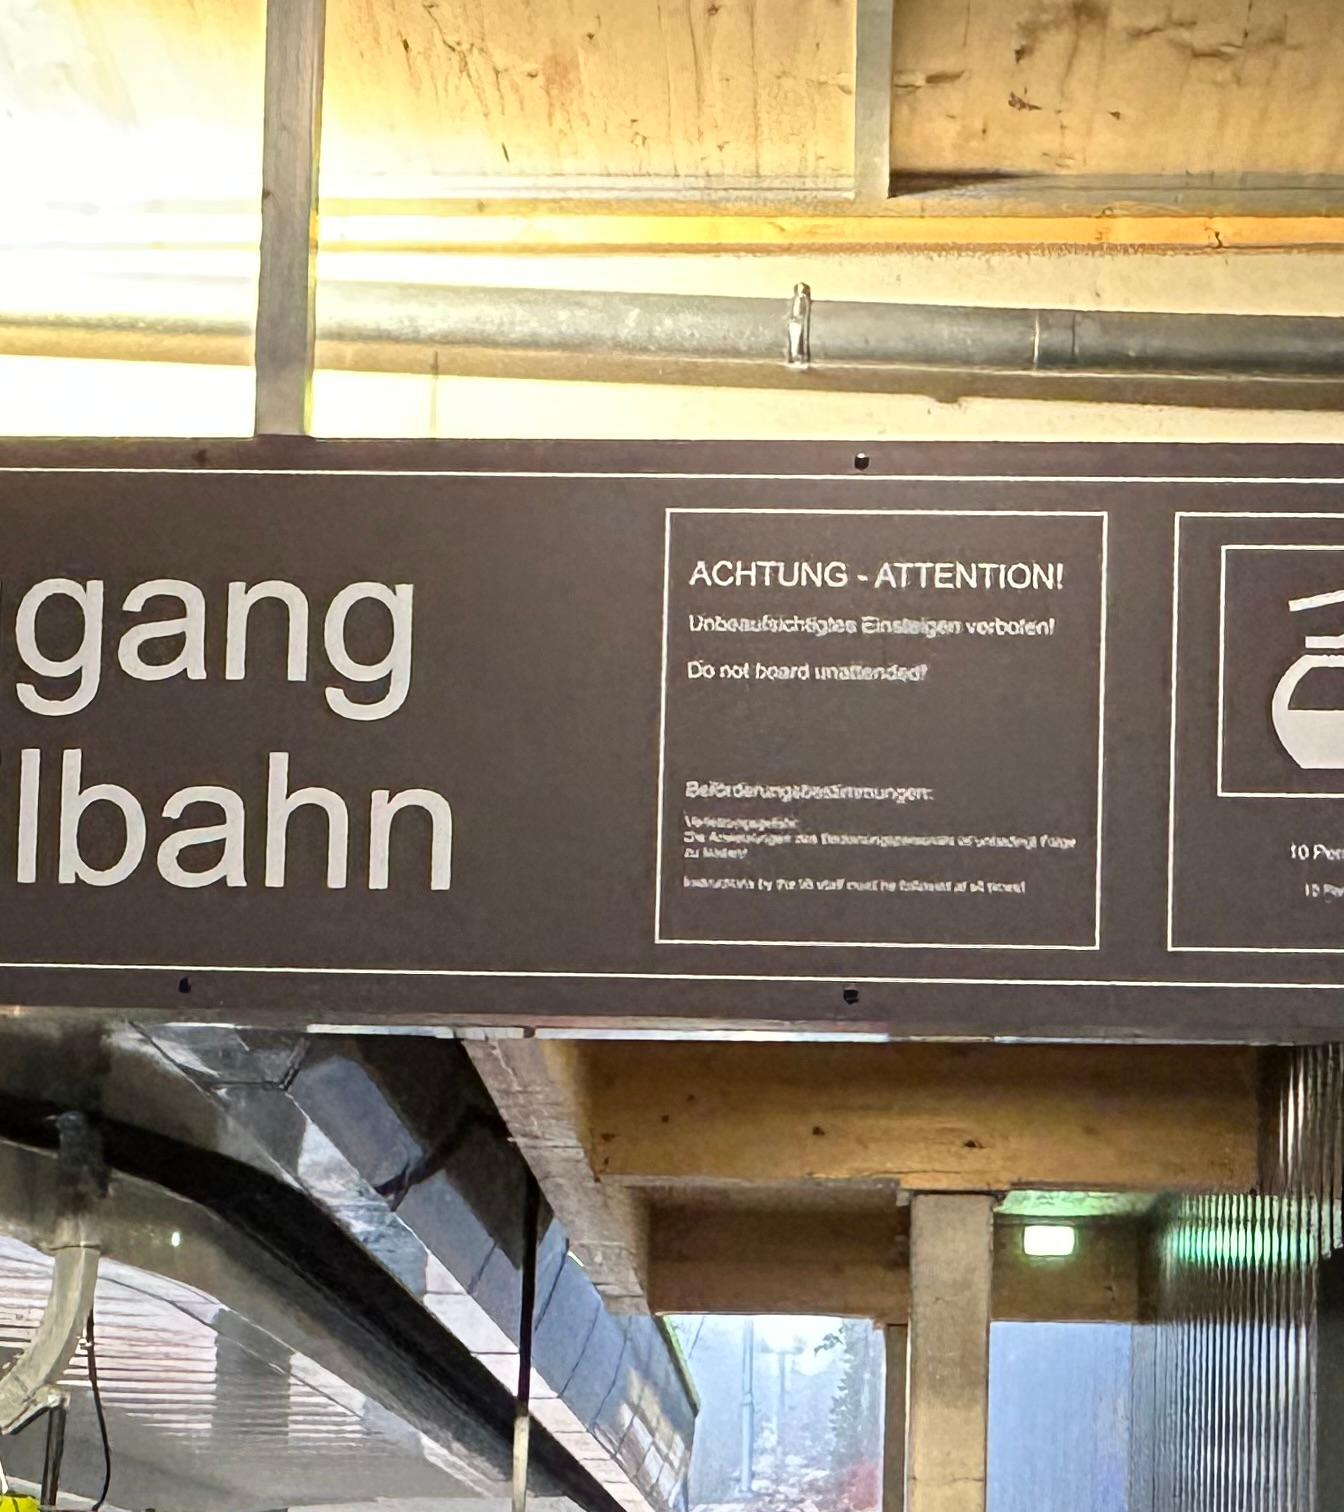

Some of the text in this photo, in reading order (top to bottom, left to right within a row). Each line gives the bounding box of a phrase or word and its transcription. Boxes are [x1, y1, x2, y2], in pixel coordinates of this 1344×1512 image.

[688, 559, 850, 588] ACHTUNG
[873, 559, 1064, 591] ATTENTION!
[687, 660, 716, 680] Do
[719, 661, 750, 680] not
[752, 661, 811, 681] board
[1290, 842, 1309, 861] 10
